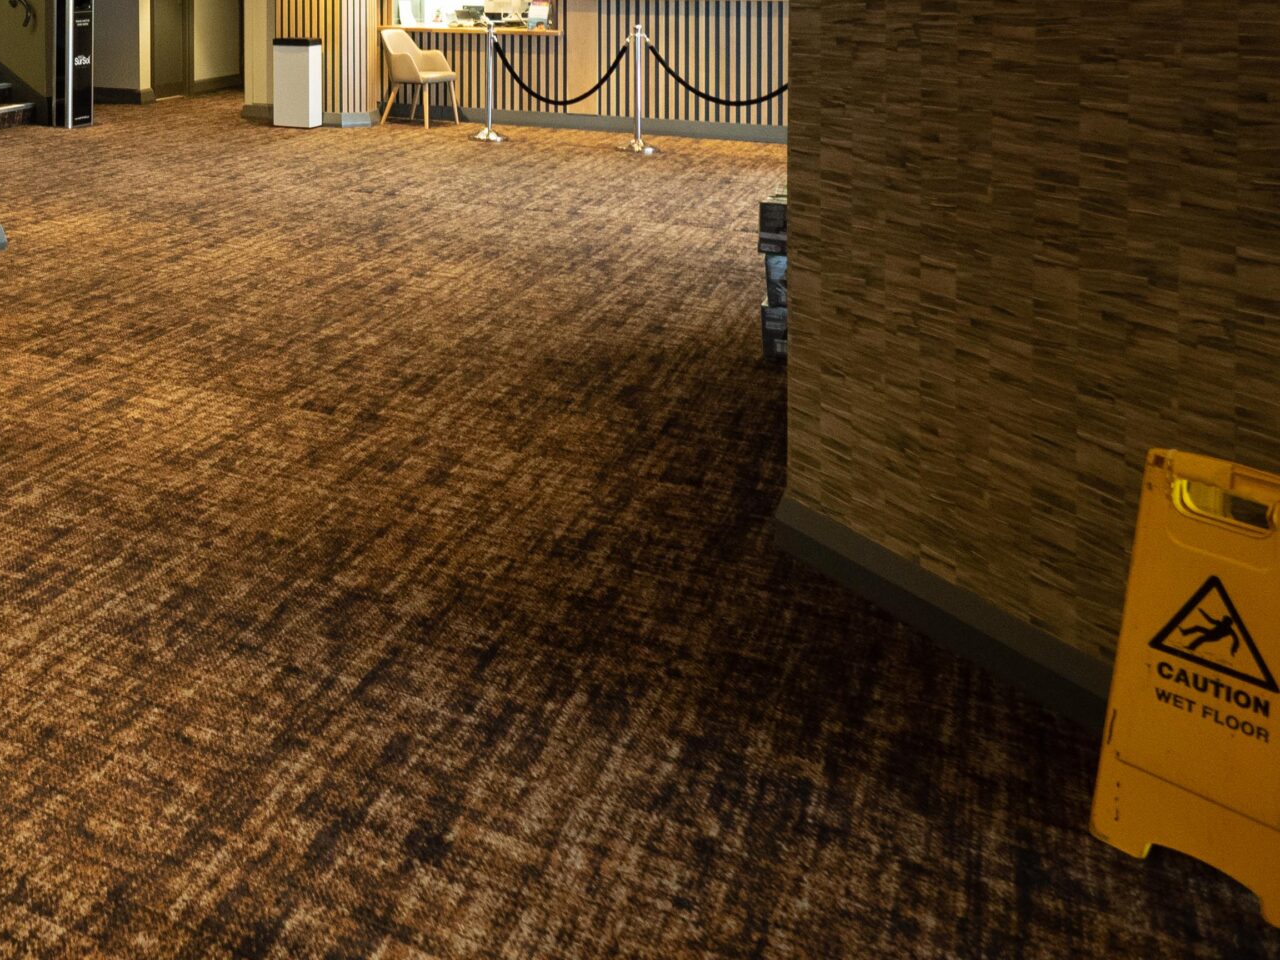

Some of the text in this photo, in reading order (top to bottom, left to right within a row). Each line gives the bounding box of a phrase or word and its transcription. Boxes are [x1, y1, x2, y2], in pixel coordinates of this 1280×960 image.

[1155, 687, 1269, 743] WET FLOOR
[1157, 661, 1270, 718] CAUTION
